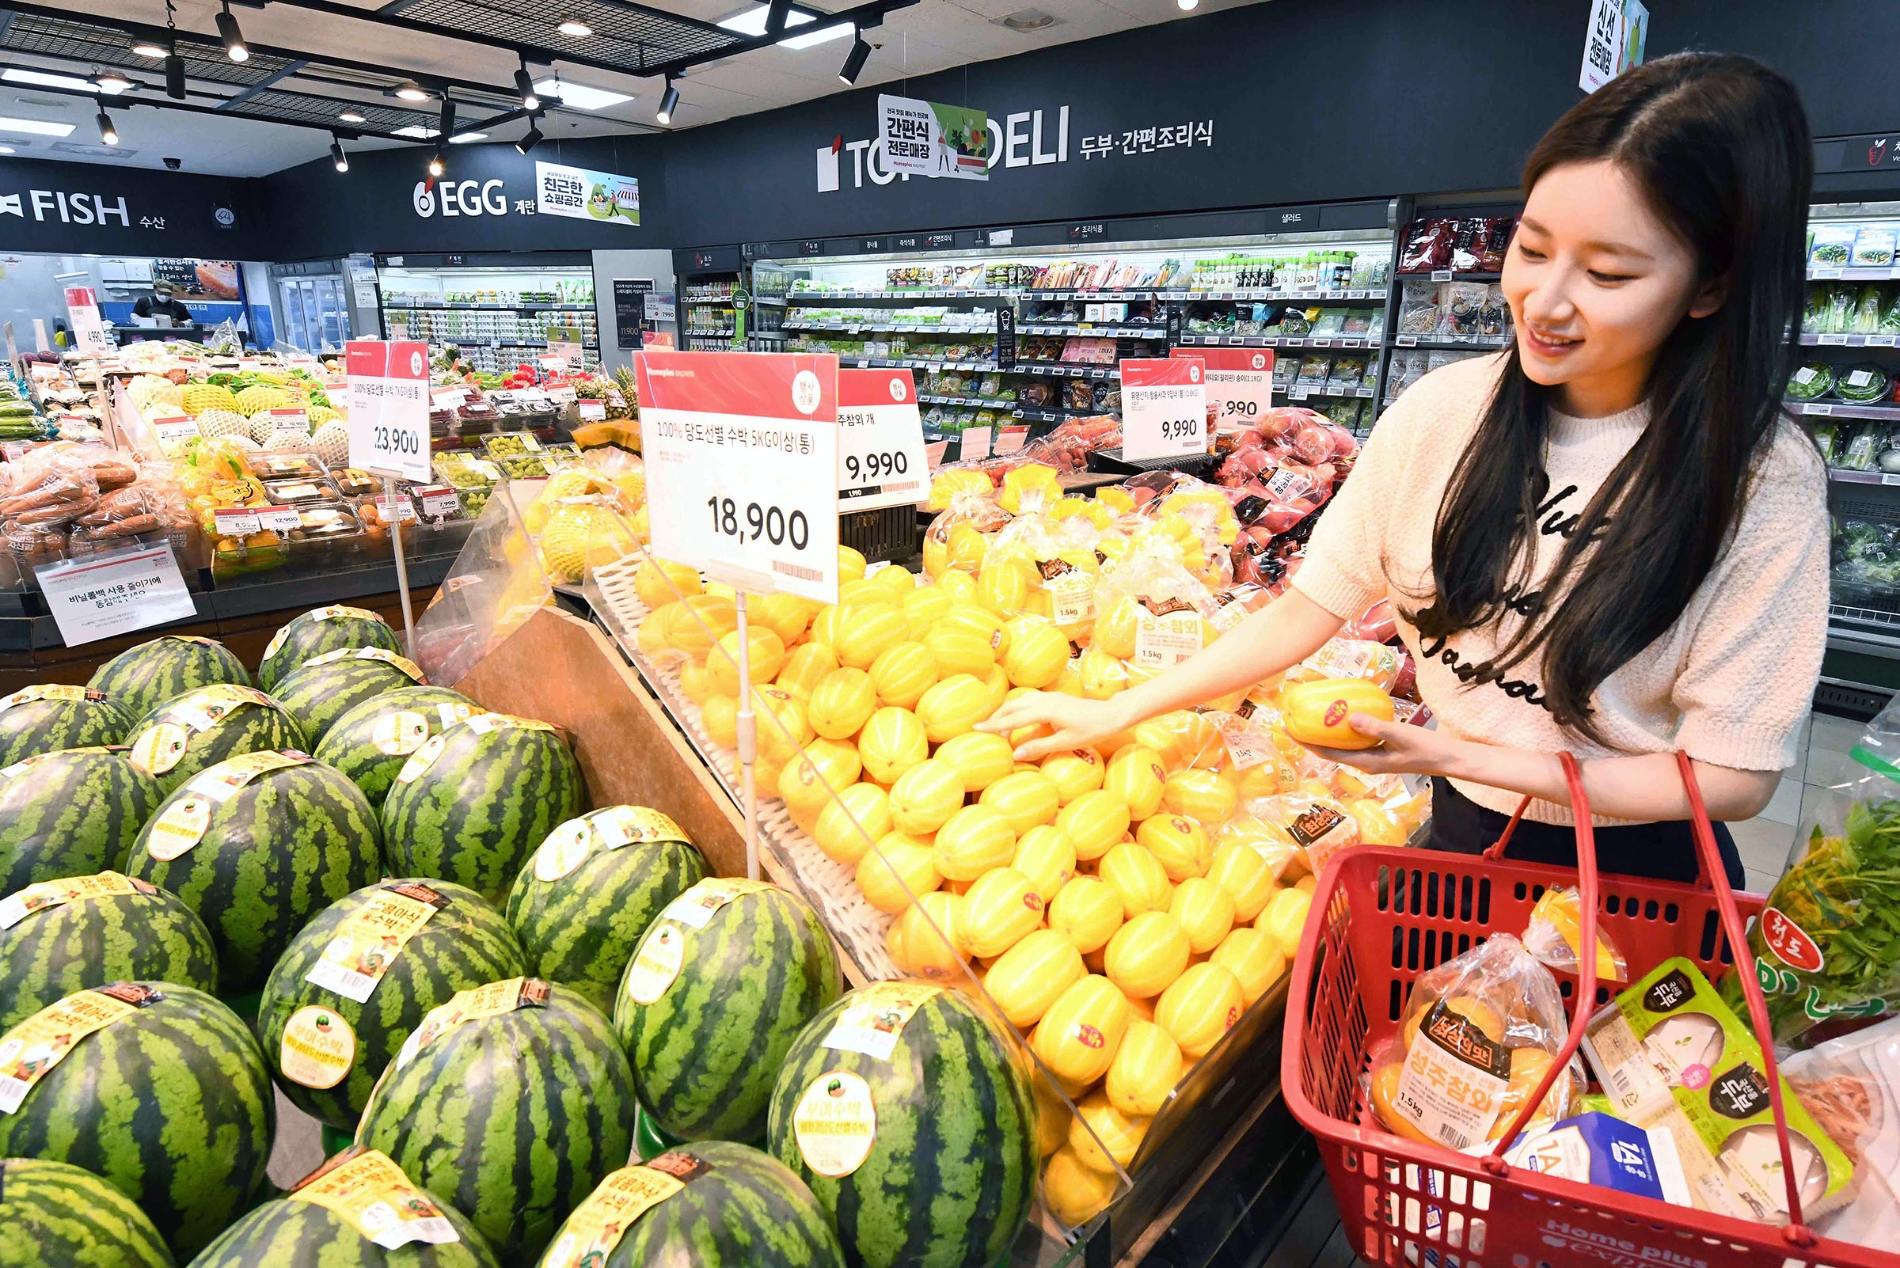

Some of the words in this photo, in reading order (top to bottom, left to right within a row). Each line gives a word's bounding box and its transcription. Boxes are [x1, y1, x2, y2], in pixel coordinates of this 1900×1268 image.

[1597, 1, 1616, 46] 신선
[888, 117, 929, 142] 간편식
[888, 140, 930, 159] 전문매장
[439, 179, 508, 217] EGG
[544, 176, 583, 196] 친근한
[30, 190, 130, 227] FISH
[514, 199, 536, 216] 계란
[544, 193, 584, 208] 쇼핑공간
[140, 216, 166, 230] 수산
[1282, 213, 1302, 224] 샐러드
[866, 413, 875, 425] 개
[1162, 419, 1197, 441] 9,990
[374, 426, 419, 455] 23,900
[656, 421, 683, 439] 100%
[685, 423, 725, 446] 당도선별
[727, 427, 749, 447] 수박
[751, 429, 815, 455] 5KG이상(통)
[846, 450, 908, 483] 9,990
[708, 496, 809, 551] 18,900
[108, 584, 125, 596] 사용
[127, 576, 162, 590] 줄이기에
[1060, 608, 1078, 617] 1.5kg
[1142, 650, 1162, 660] 1.5kg
[1654, 982, 1678, 1008] 두부
[1410, 1050, 1494, 1115] 성주참외
[1400, 1092, 1424, 1119] 1.5kg
[1720, 1078, 1753, 1113] 두부
[1546, 1220, 1636, 1250] Home
